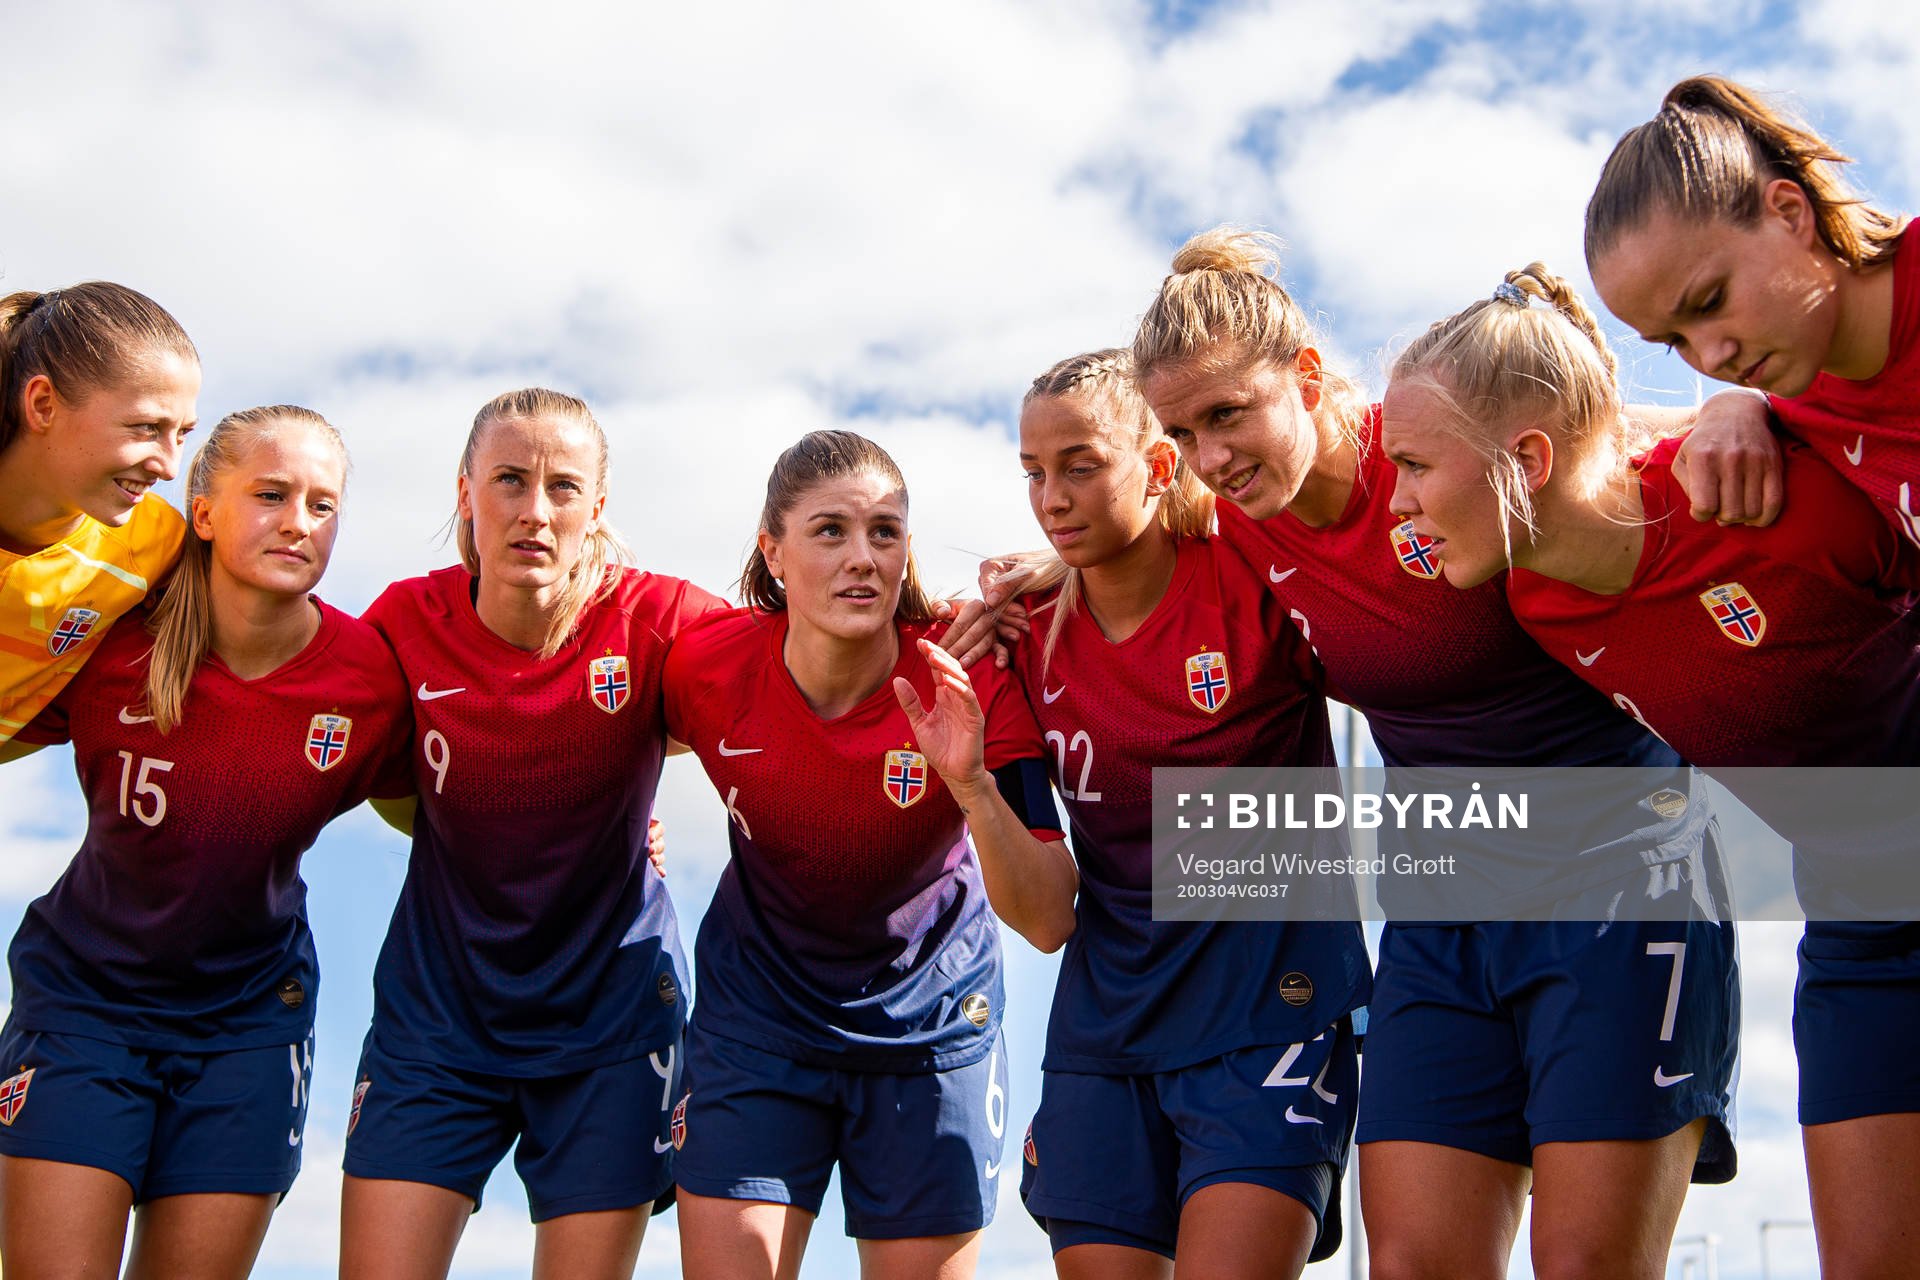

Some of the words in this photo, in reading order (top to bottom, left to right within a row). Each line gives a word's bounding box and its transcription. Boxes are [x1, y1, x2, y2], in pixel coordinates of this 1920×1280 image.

[118, 750, 175, 827] 15
[424, 729, 450, 794] 9
[1045, 730, 1102, 801] 22
[1646, 942, 1686, 1041] 7
[985, 1052, 1004, 1139] 6
